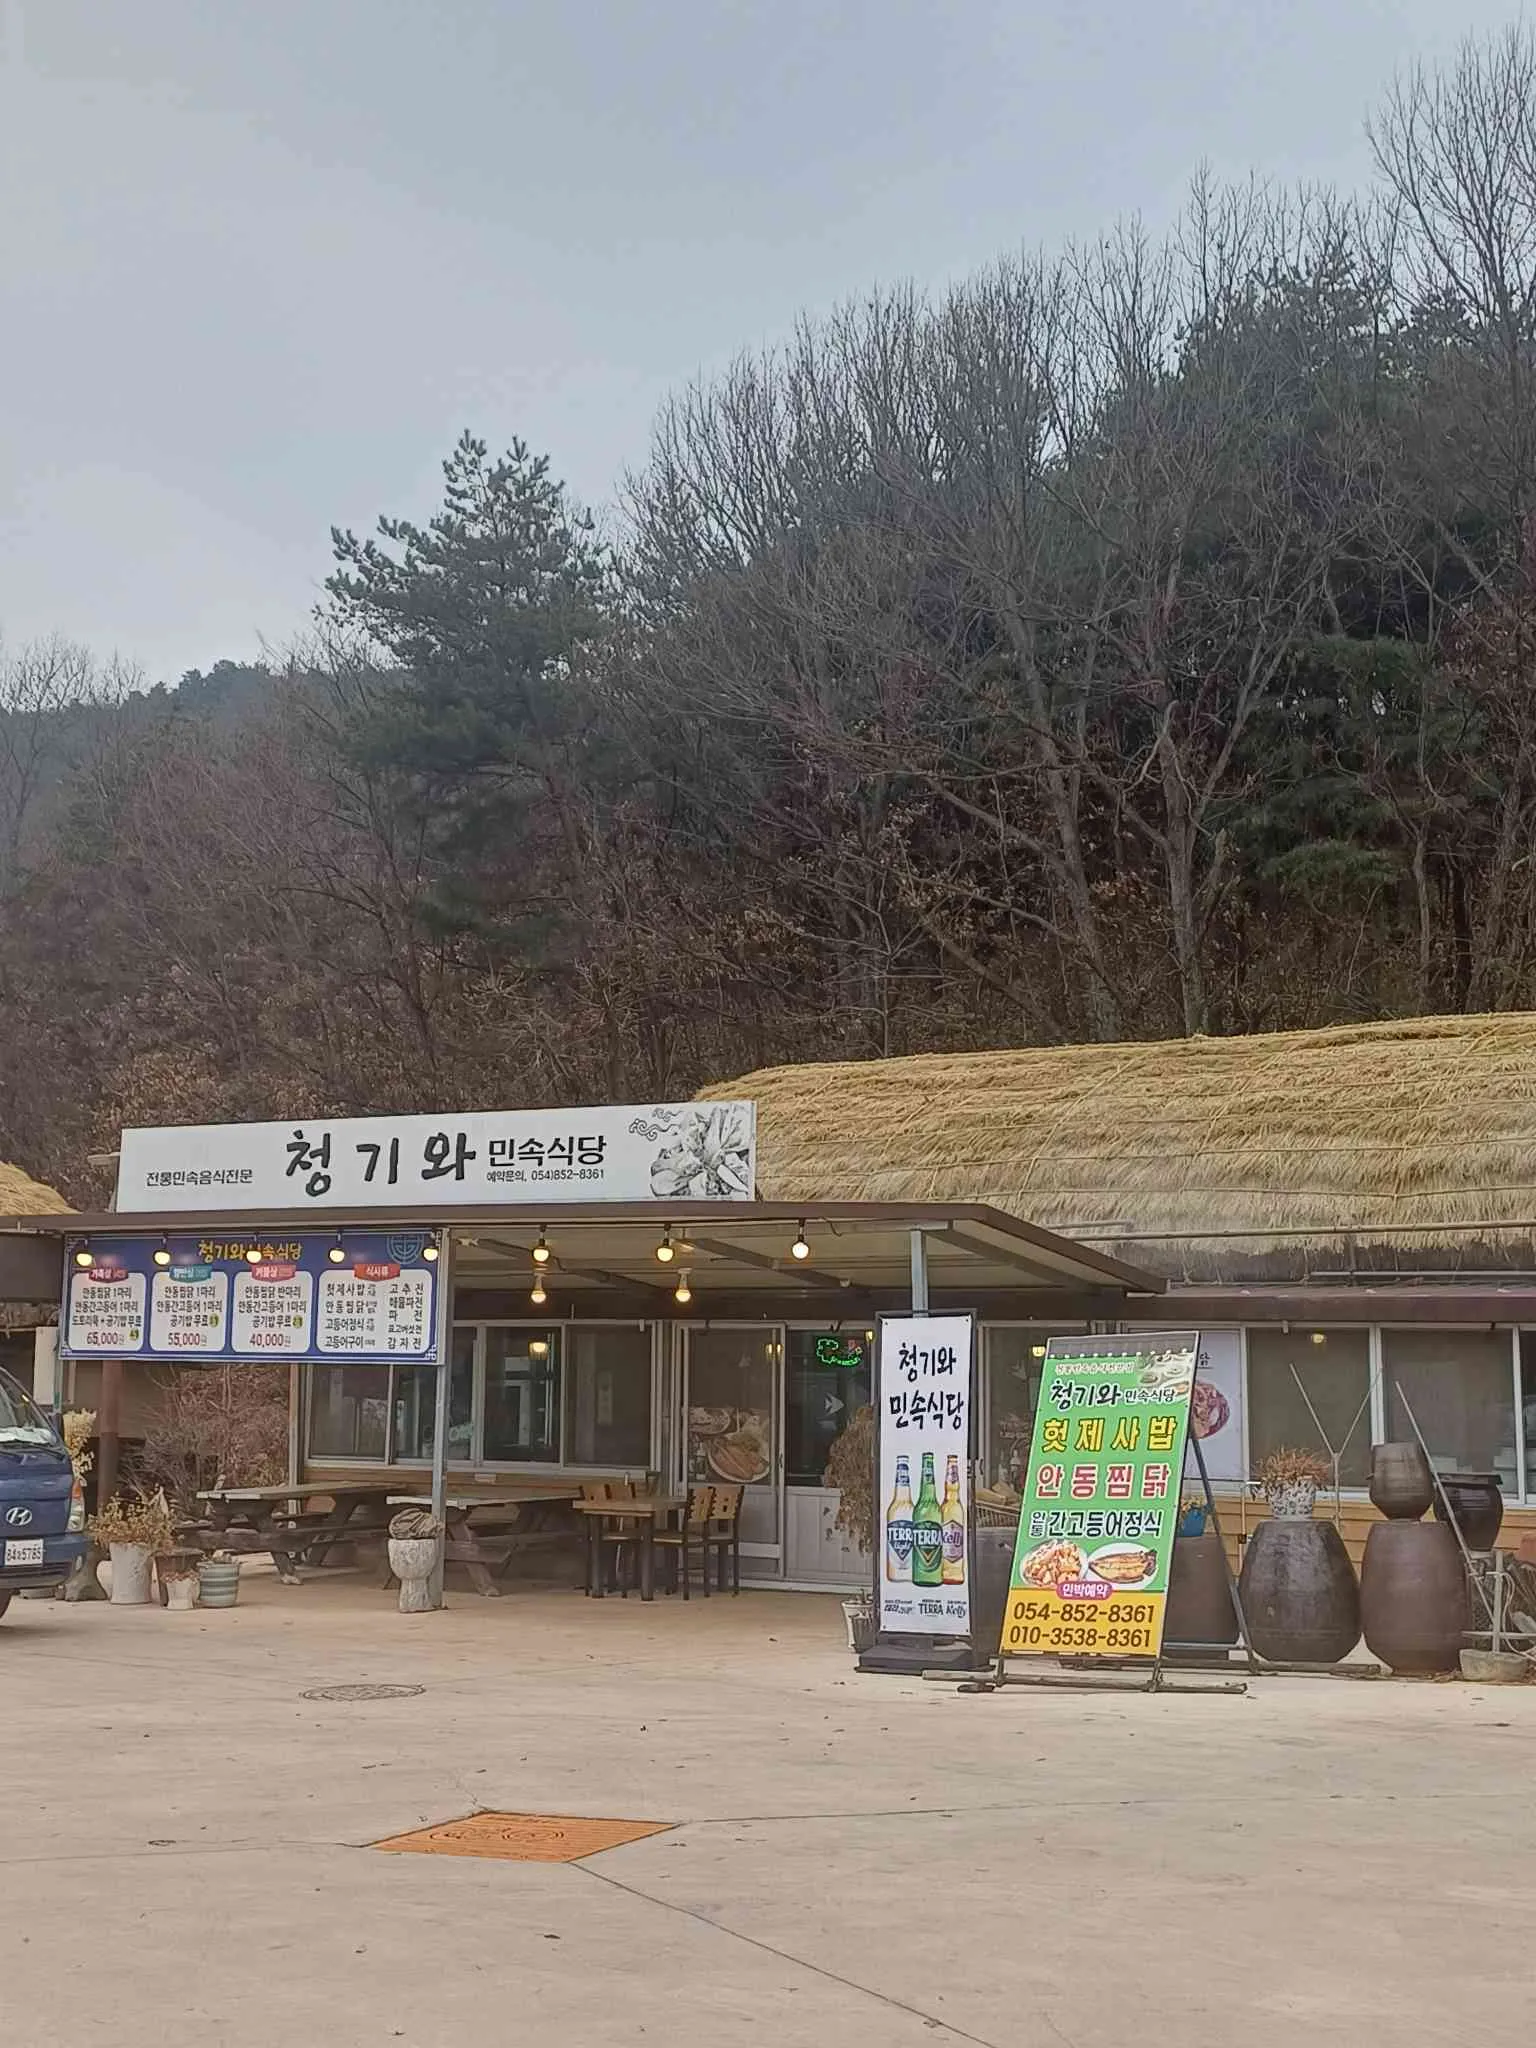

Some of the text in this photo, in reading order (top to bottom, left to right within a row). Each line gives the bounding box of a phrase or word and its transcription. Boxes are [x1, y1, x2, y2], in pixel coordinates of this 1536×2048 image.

[286, 1129, 608, 1197] 청기와 민속식당
[530, 1168, 605, 1181] 054)852-8361
[145, 1168, 254, 1187] 전통민속음식전문
[198, 1239, 246, 1263] 청기와
[898, 1342, 957, 1383] 청기와
[1050, 1380, 1176, 1411] 청기와 민속식당
[889, 1390, 965, 1429] 민속식당
[1042, 1416, 1177, 1452] 헛제사밥
[1036, 1464, 1171, 1499] 안동찜닭
[1048, 1510, 1163, 1538] 간고등어정식
[913, 1530, 943, 1546] TERRA
[918, 1603, 943, 1615] TERRA
[1013, 1602, 1155, 1624] 054-852-8361
[1009, 1626, 1151, 1647] 010-3538-8361
